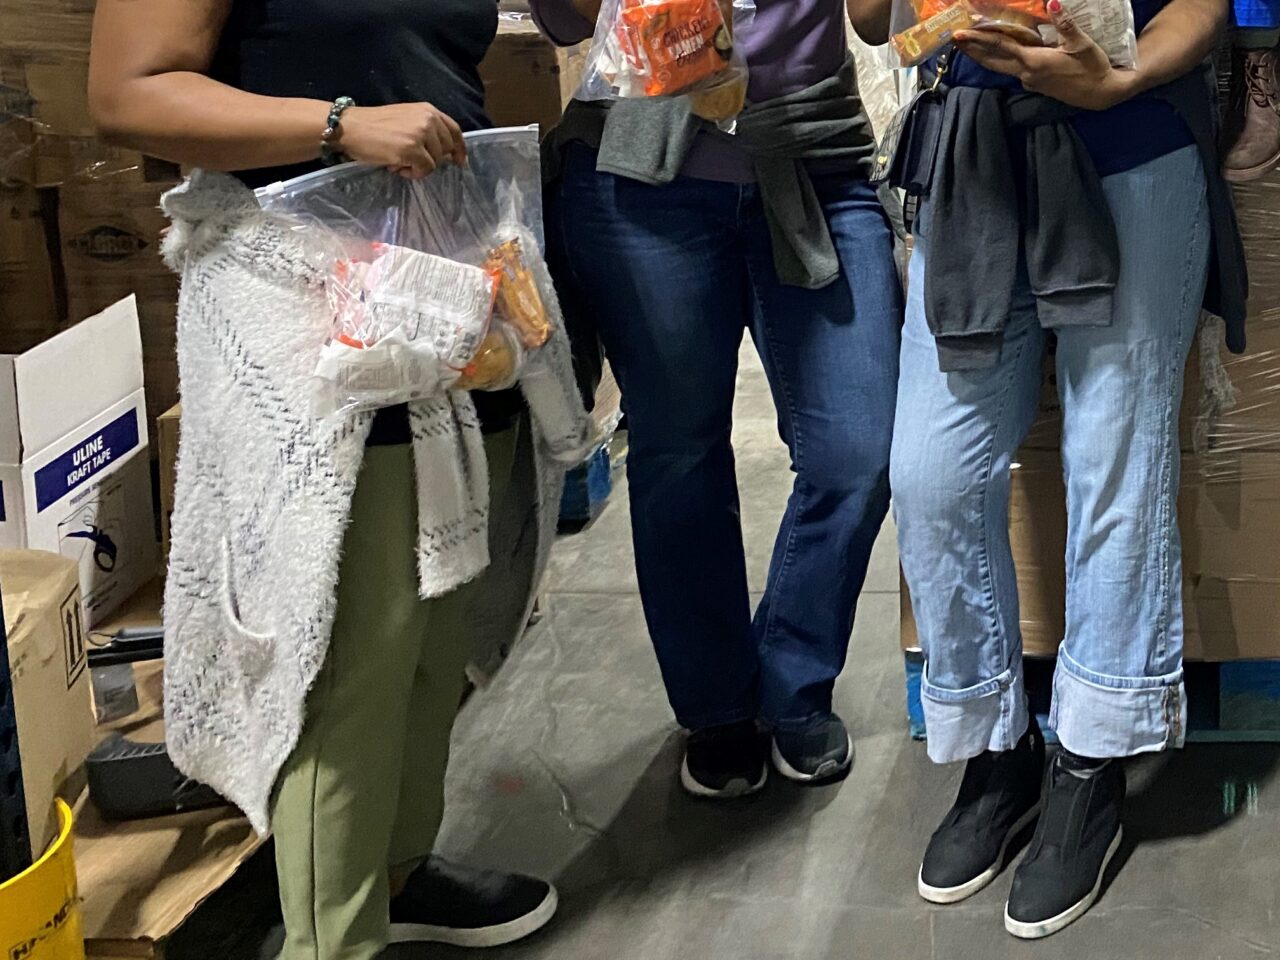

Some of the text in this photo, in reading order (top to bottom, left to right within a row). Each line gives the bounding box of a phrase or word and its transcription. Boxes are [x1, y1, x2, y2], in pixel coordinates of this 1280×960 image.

[67, 463, 92, 487] KRAFT
[92, 448, 111, 470] TAPE
[72, 434, 104, 466] ULINE
